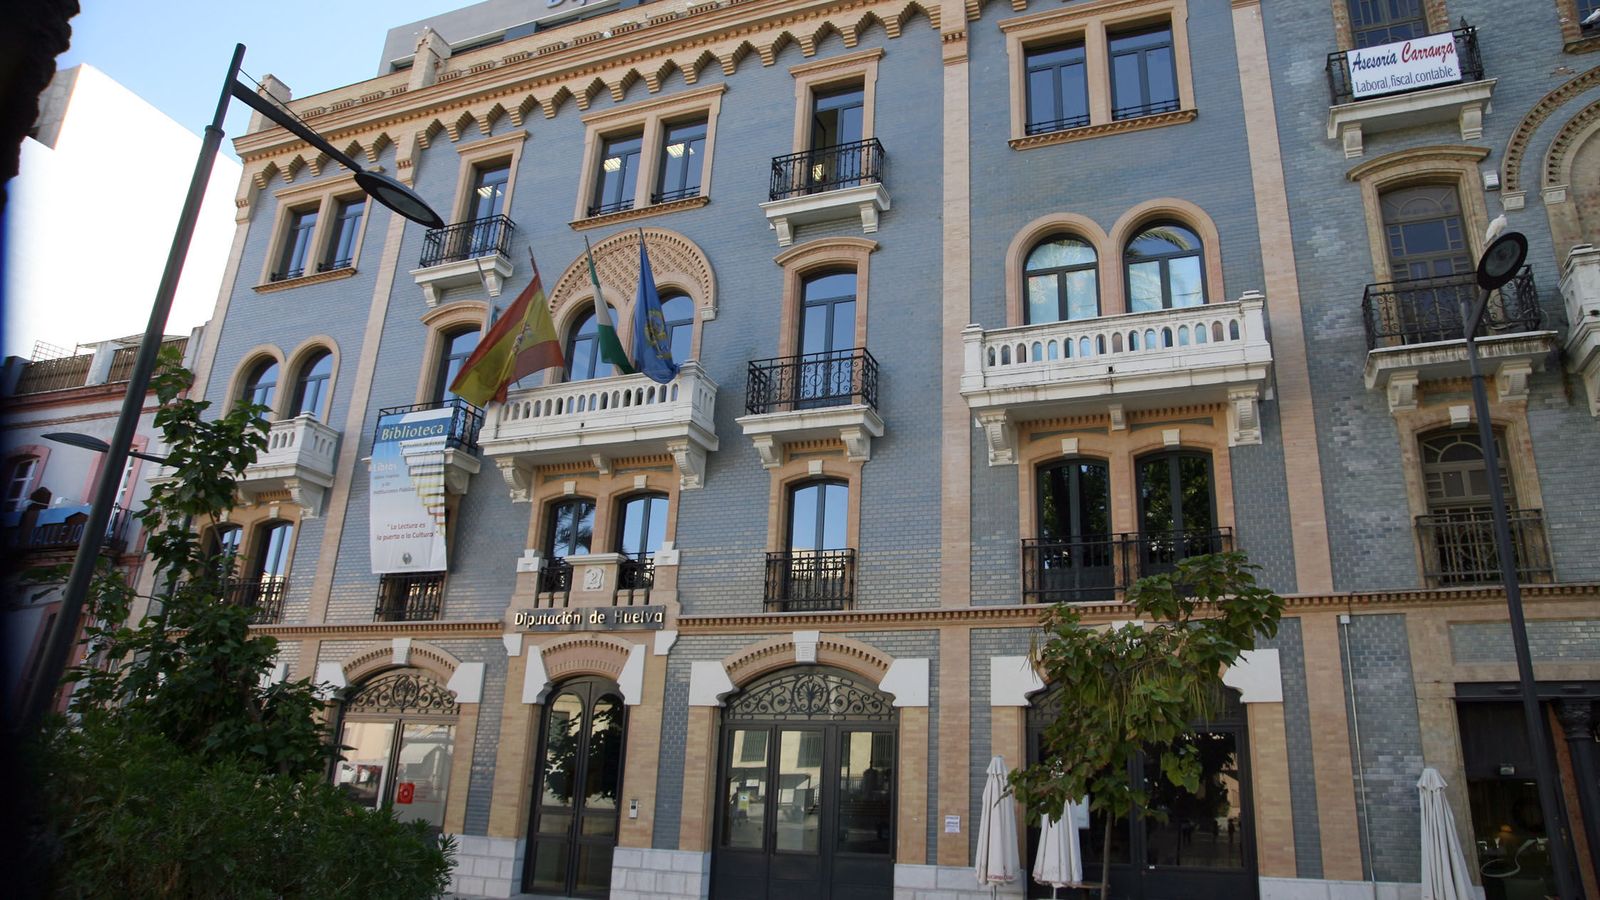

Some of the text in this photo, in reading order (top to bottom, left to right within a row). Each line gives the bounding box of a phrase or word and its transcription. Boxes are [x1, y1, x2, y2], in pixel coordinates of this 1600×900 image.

[1401, 41, 1454, 63] Carranza
[381, 424, 444, 441] Biblioteca
[514, 610, 663, 628] Diputación de Huelva
